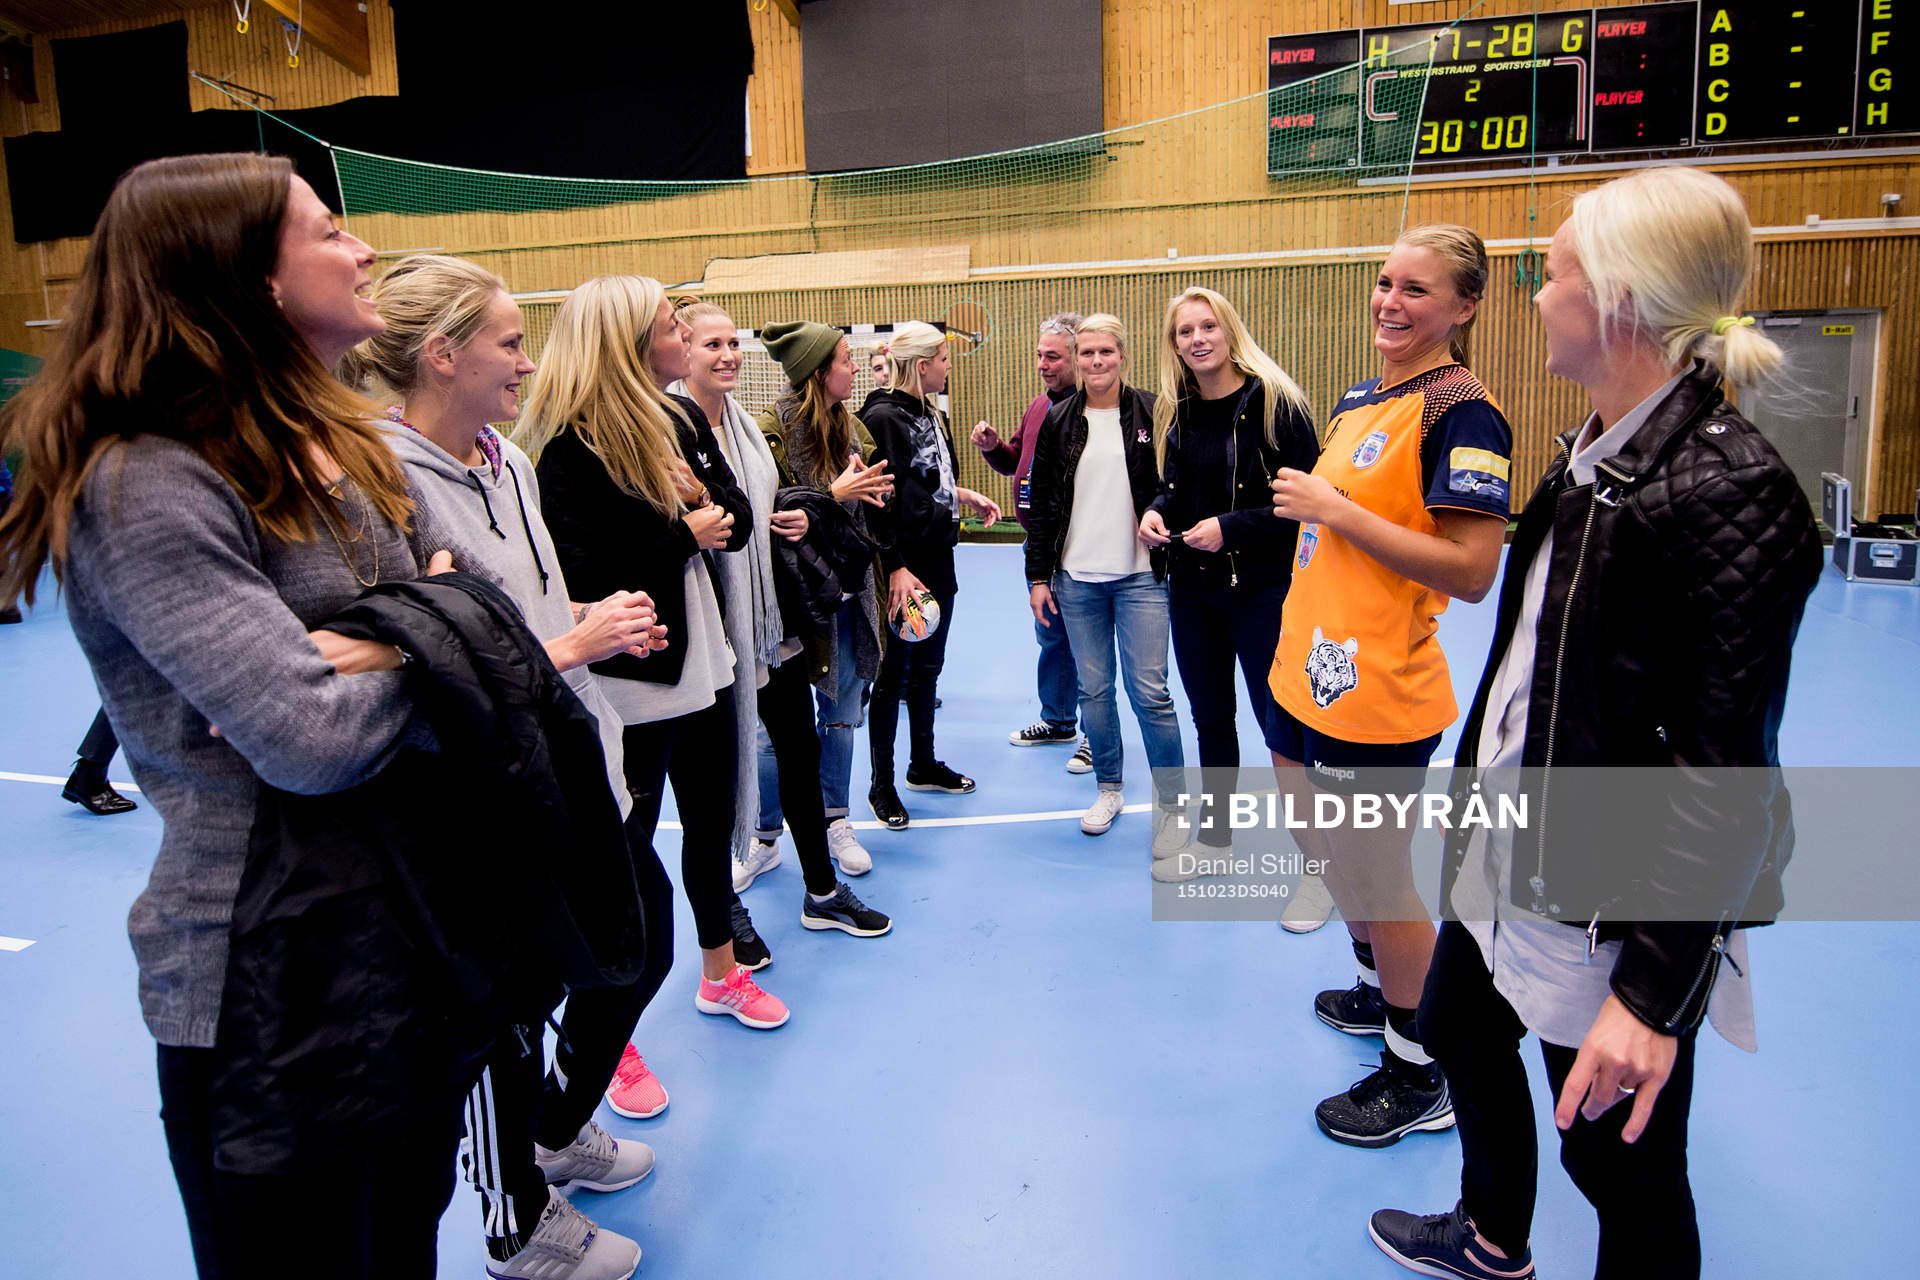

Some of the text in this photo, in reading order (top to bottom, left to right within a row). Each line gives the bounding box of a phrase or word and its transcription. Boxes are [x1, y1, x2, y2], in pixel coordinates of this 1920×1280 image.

[1709, 9, 1732, 33] A
[1873, 0, 1892, 20] E
[1597, 21, 1646, 38] PLAYER
[1367, 35, 1389, 69] H
[1561, 19, 1584, 53] G
[1871, 31, 1890, 55] F
[1270, 48, 1316, 65] PLAYER
[1709, 43, 1730, 67] B
[1400, 58, 1551, 79] WESTERSTRAND SPORTSYSTEM
[1868, 68, 1892, 92] G
[1464, 79, 1481, 102] 2
[1595, 90, 1644, 107] PLAYER
[1707, 79, 1729, 102] C
[1270, 113, 1316, 129] PLAYER
[1705, 113, 1727, 136] D
[1867, 102, 1888, 125] H
[1314, 759, 1355, 781] Kempa
